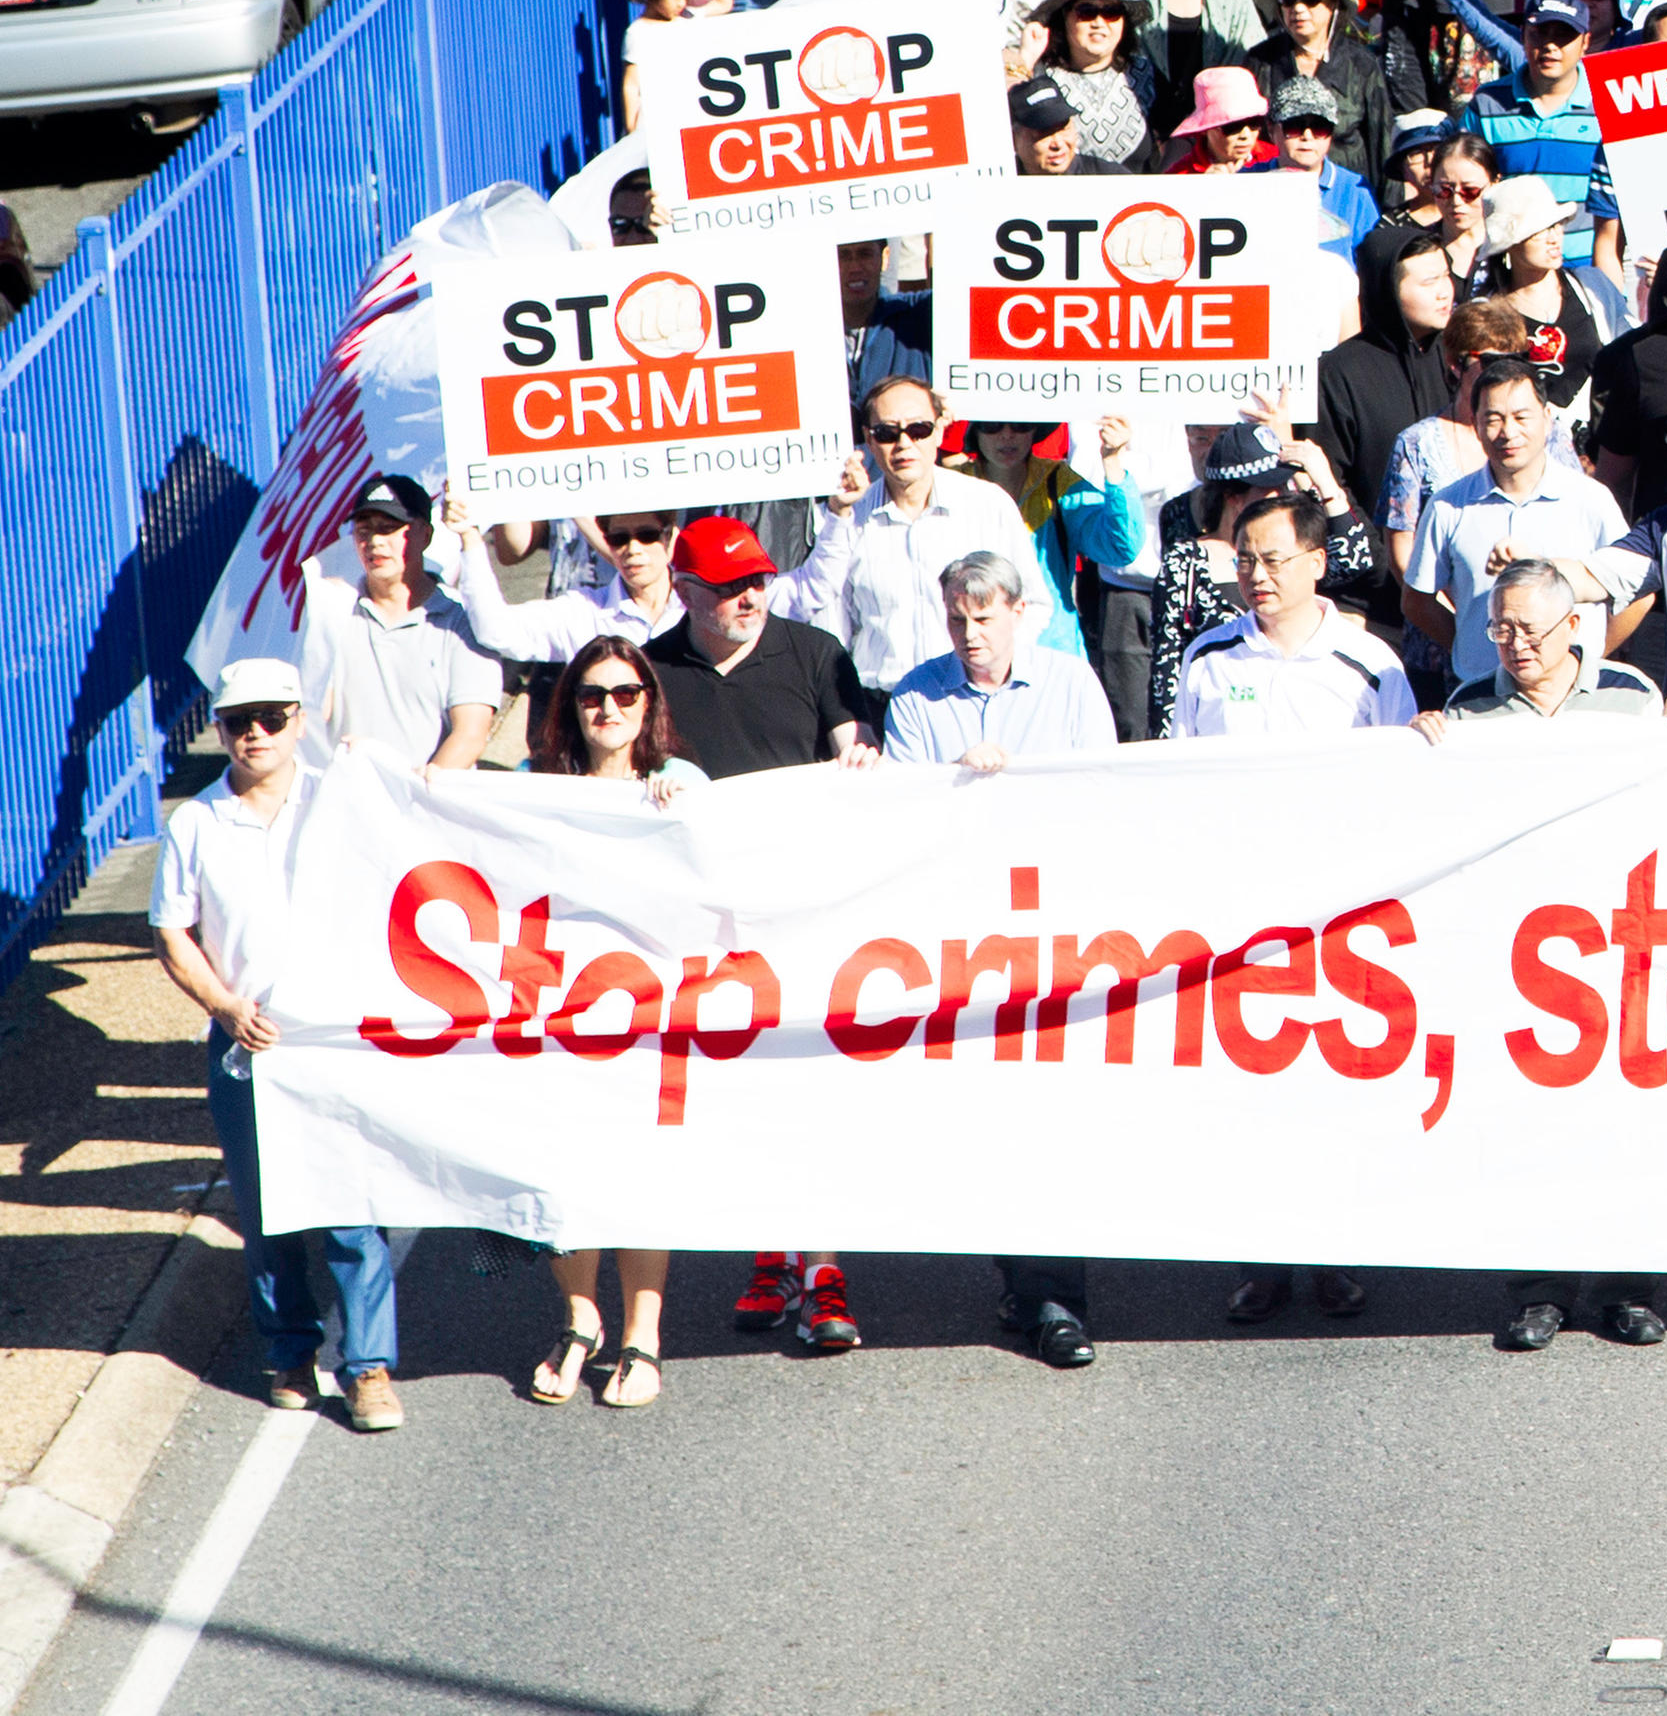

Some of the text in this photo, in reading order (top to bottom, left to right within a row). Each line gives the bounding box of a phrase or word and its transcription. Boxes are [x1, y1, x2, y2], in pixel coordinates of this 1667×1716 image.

[708, 104, 934, 184] CR!ME
[669, 194, 796, 234] Enough
[809, 189, 835, 215] is
[998, 293, 1234, 350] CR!ME
[512, 362, 762, 440] CR!ME
[948, 364, 1305, 400] Enough is Enough!!!
[466, 431, 840, 493] Enough is Enough!!!
[360, 859, 781, 1126] Stop
[823, 866, 1456, 1132] crimes,
